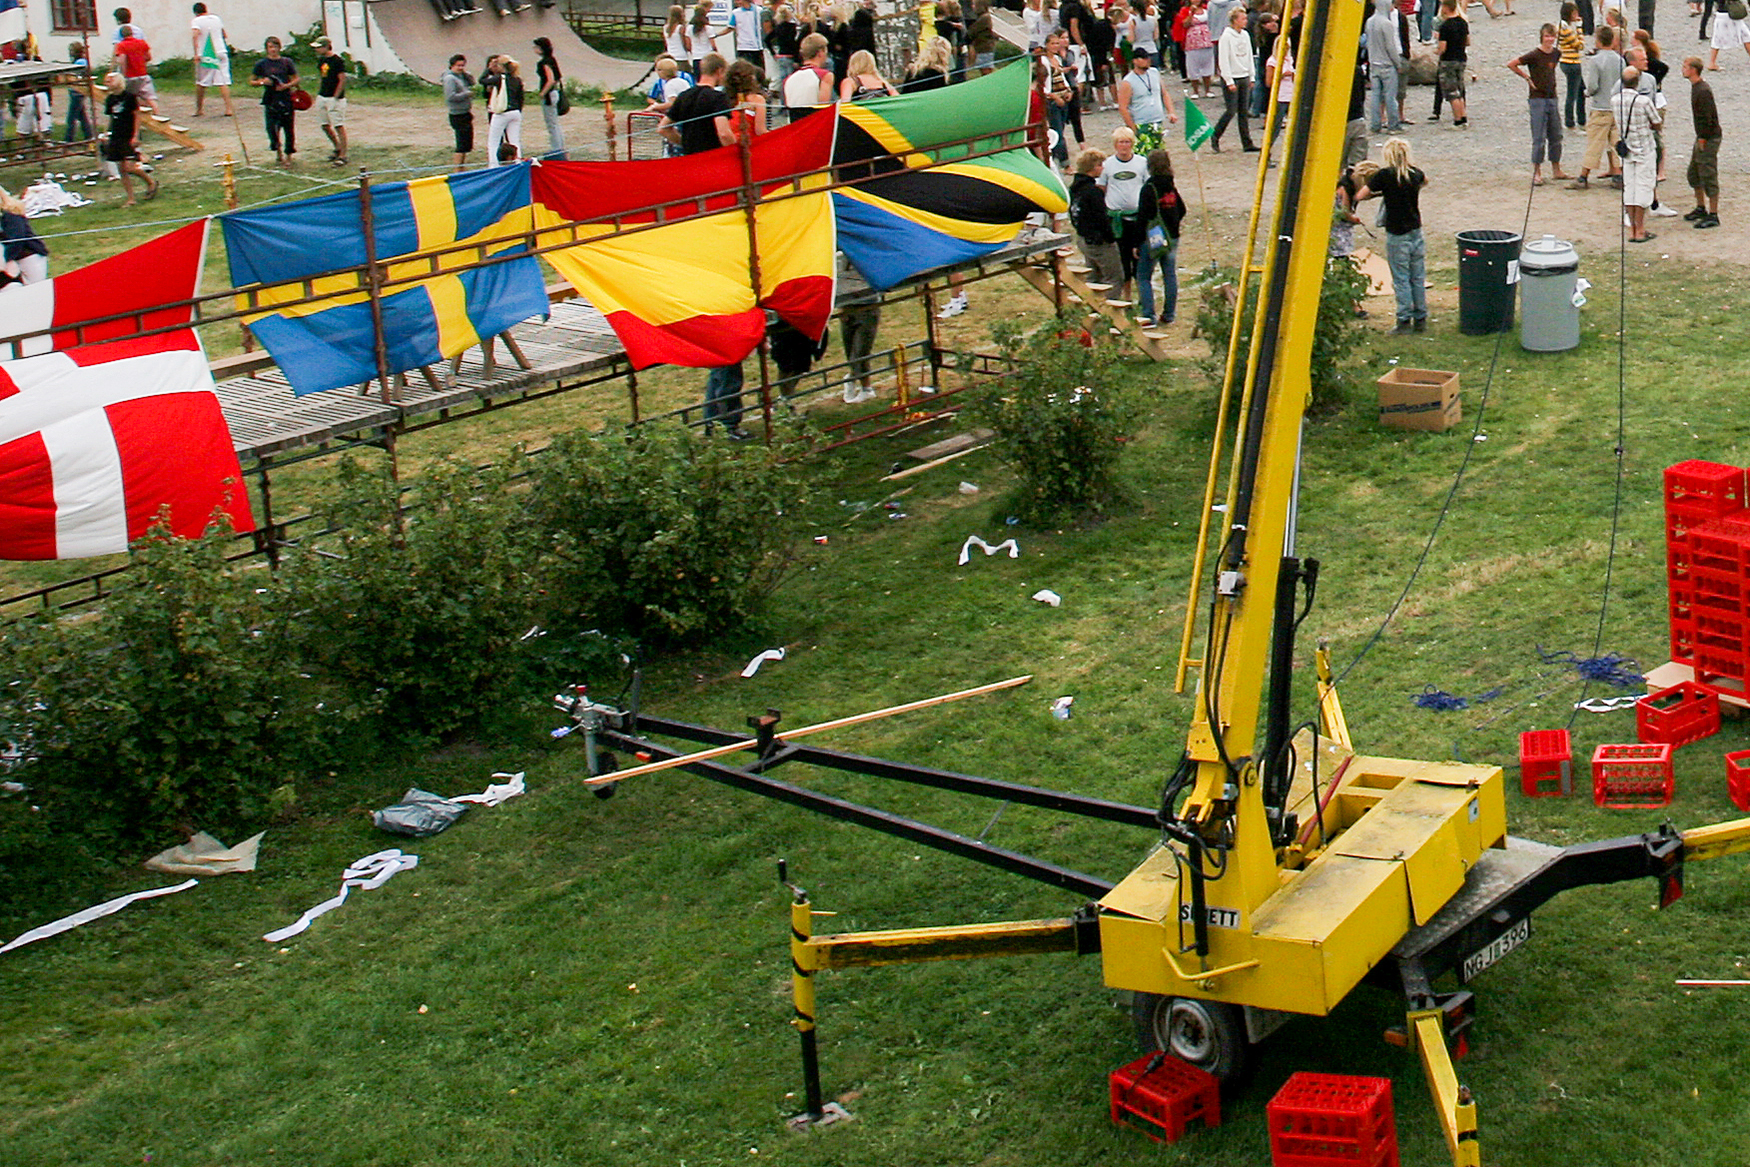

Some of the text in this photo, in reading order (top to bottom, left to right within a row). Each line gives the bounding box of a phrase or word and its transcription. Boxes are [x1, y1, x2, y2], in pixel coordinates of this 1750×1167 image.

[1180, 904, 1237, 926] SETT
[1465, 921, 1527, 981] NGJ 396
